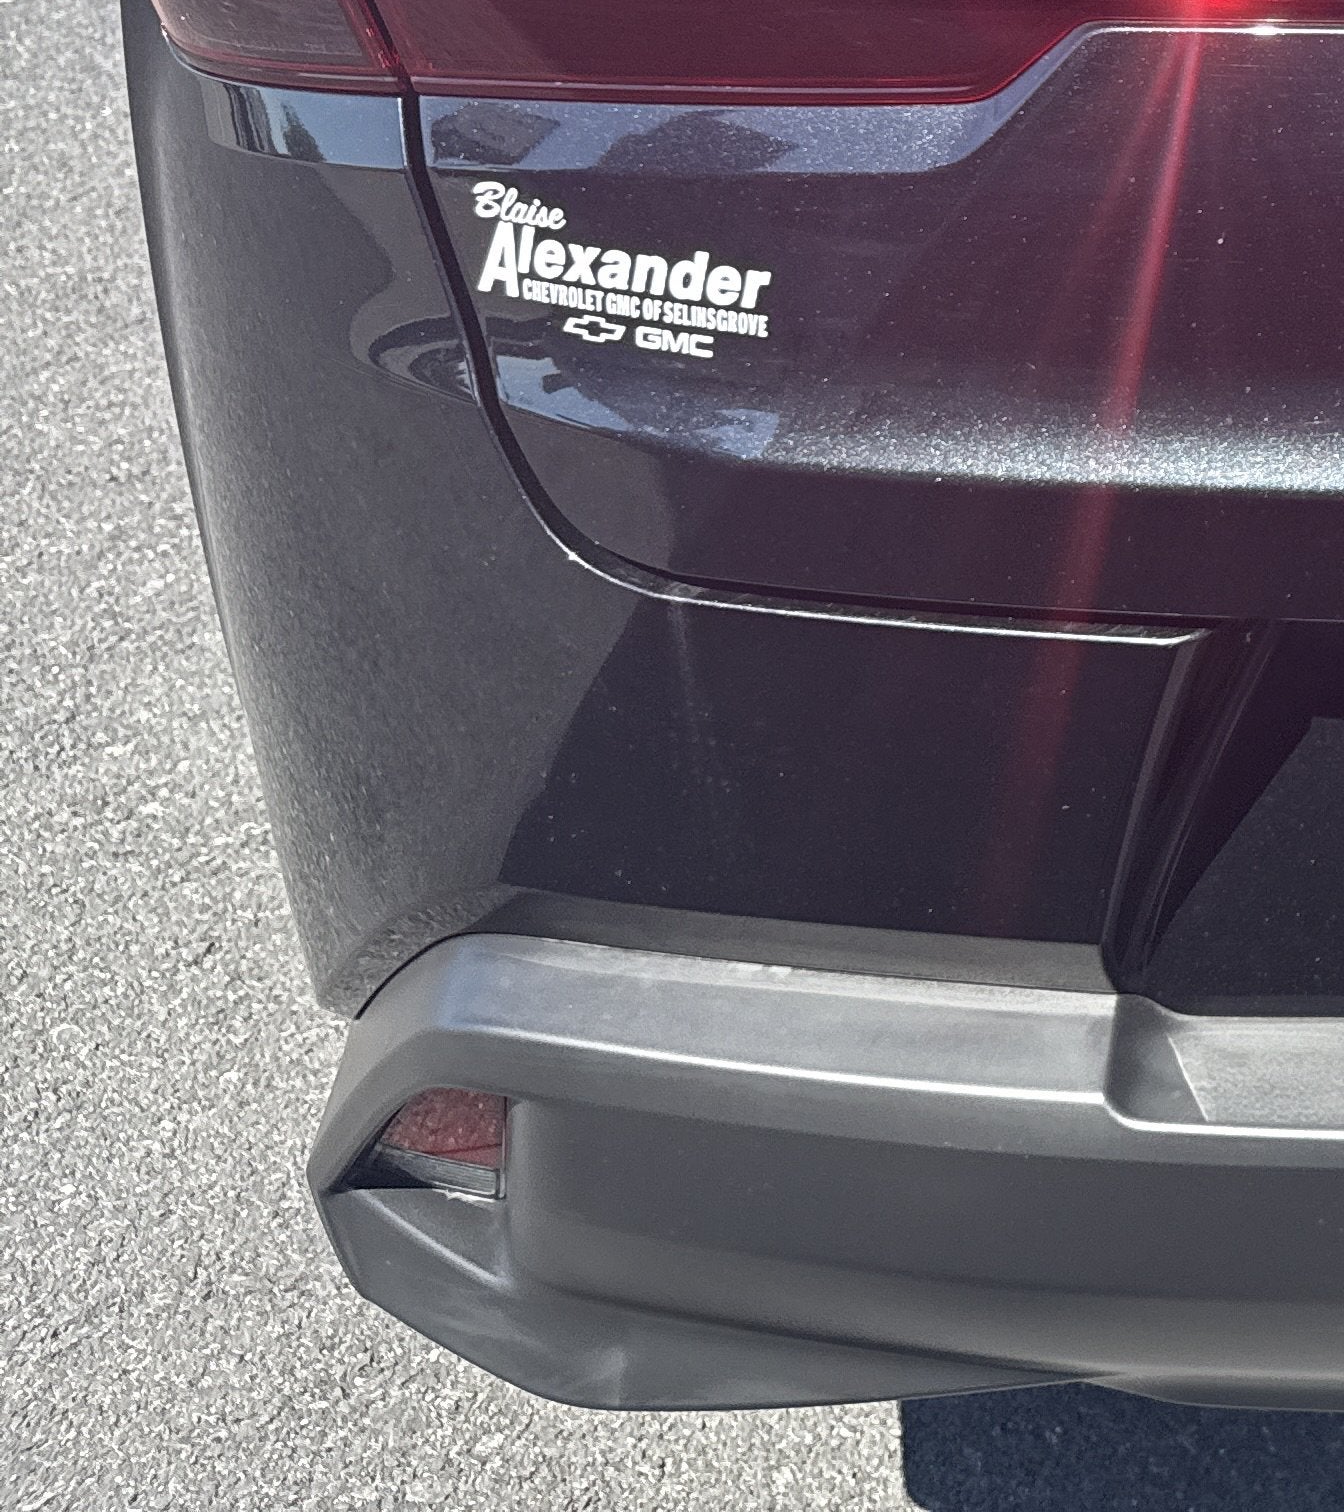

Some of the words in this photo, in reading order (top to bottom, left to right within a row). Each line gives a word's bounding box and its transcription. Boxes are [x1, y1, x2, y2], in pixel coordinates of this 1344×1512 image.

[472, 180, 567, 230] Blaise
[477, 220, 772, 309] Alexander
[522, 278, 604, 312] CHEVROLET
[605, 292, 641, 319] GMC
[642, 299, 664, 322] OF
[663, 300, 769, 338] SELINSGROVE
[635, 325, 714, 358] GMC
